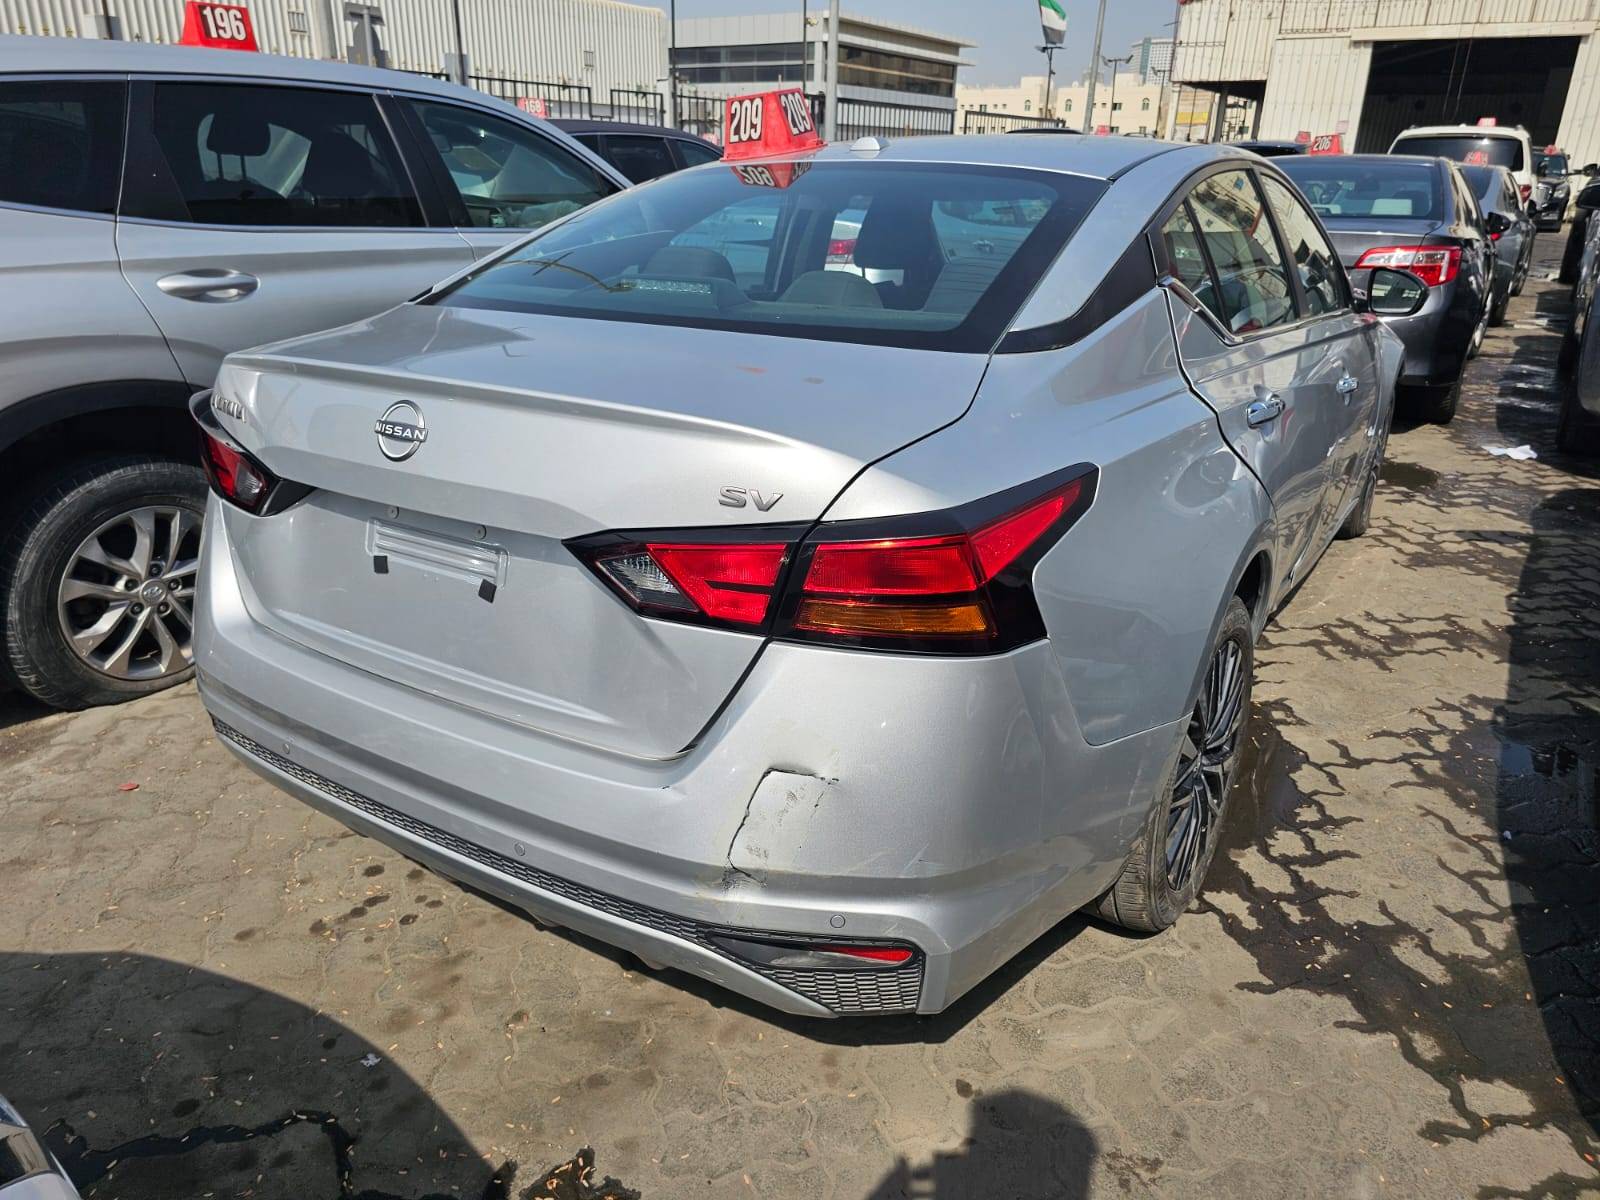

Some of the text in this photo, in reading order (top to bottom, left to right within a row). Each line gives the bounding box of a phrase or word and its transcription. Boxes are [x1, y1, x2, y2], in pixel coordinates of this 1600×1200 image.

[203, 6, 247, 41] 196
[729, 97, 763, 143] 209
[780, 92, 812, 136] 209
[1312, 135, 1333, 151] 206
[375, 421, 426, 440] NISSAN
[718, 485, 784, 512] SV
